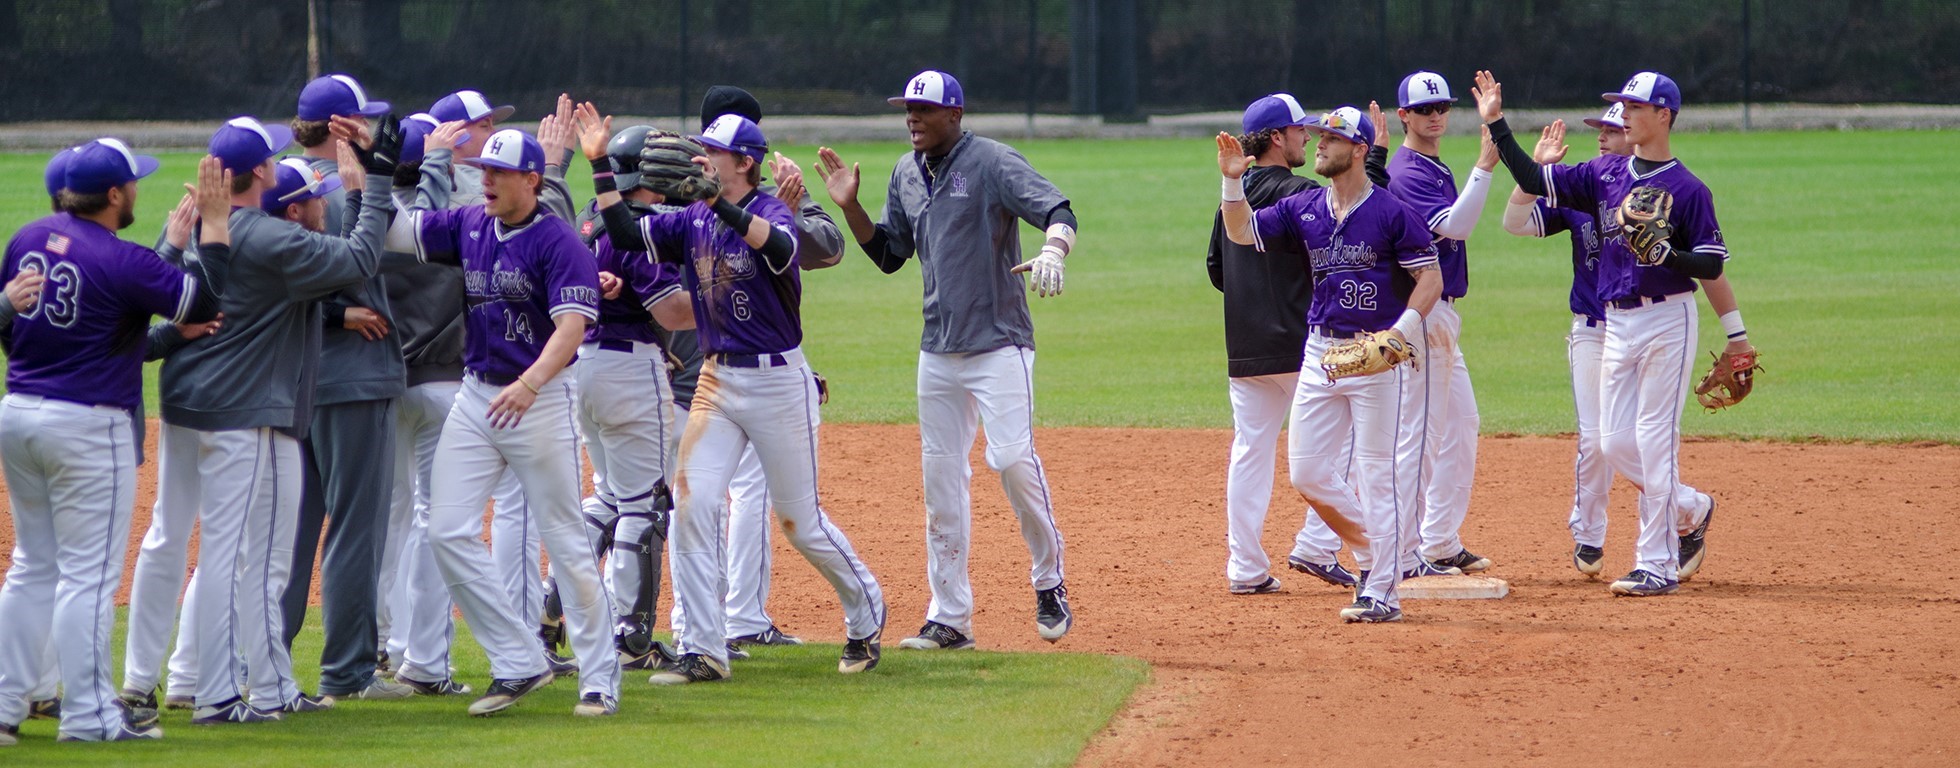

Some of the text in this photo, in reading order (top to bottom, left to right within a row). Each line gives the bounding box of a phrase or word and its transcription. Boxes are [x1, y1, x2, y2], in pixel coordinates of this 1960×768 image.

[1422, 79, 1439, 95] YH
[730, 290, 752, 322] 6
[1339, 279, 1378, 311] 32
[503, 308, 533, 345] 14
